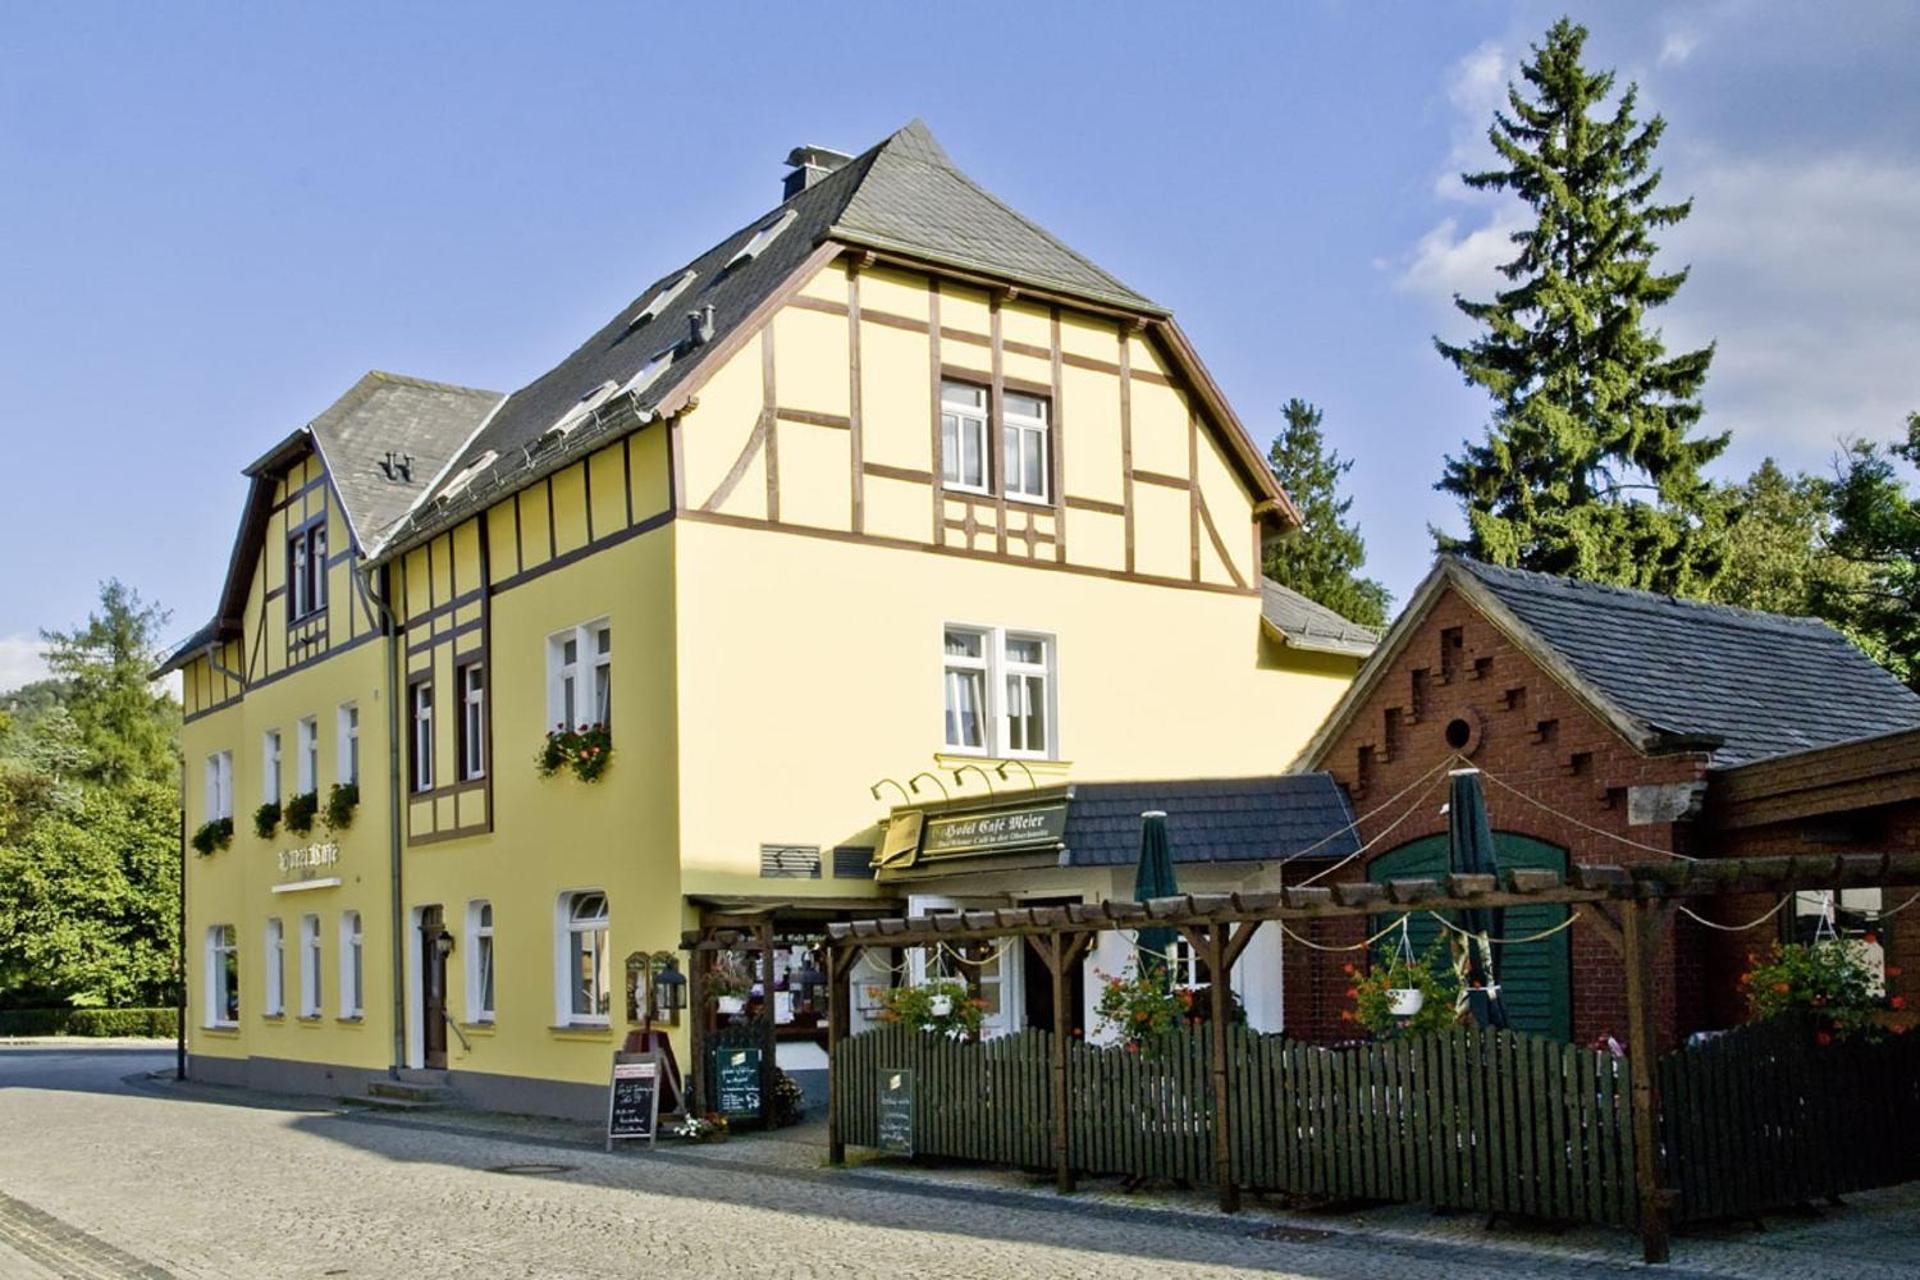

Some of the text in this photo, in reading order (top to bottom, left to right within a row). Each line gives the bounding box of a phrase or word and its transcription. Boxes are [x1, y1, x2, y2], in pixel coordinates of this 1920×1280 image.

[945, 813, 1045, 838] Hotel Café Meier
